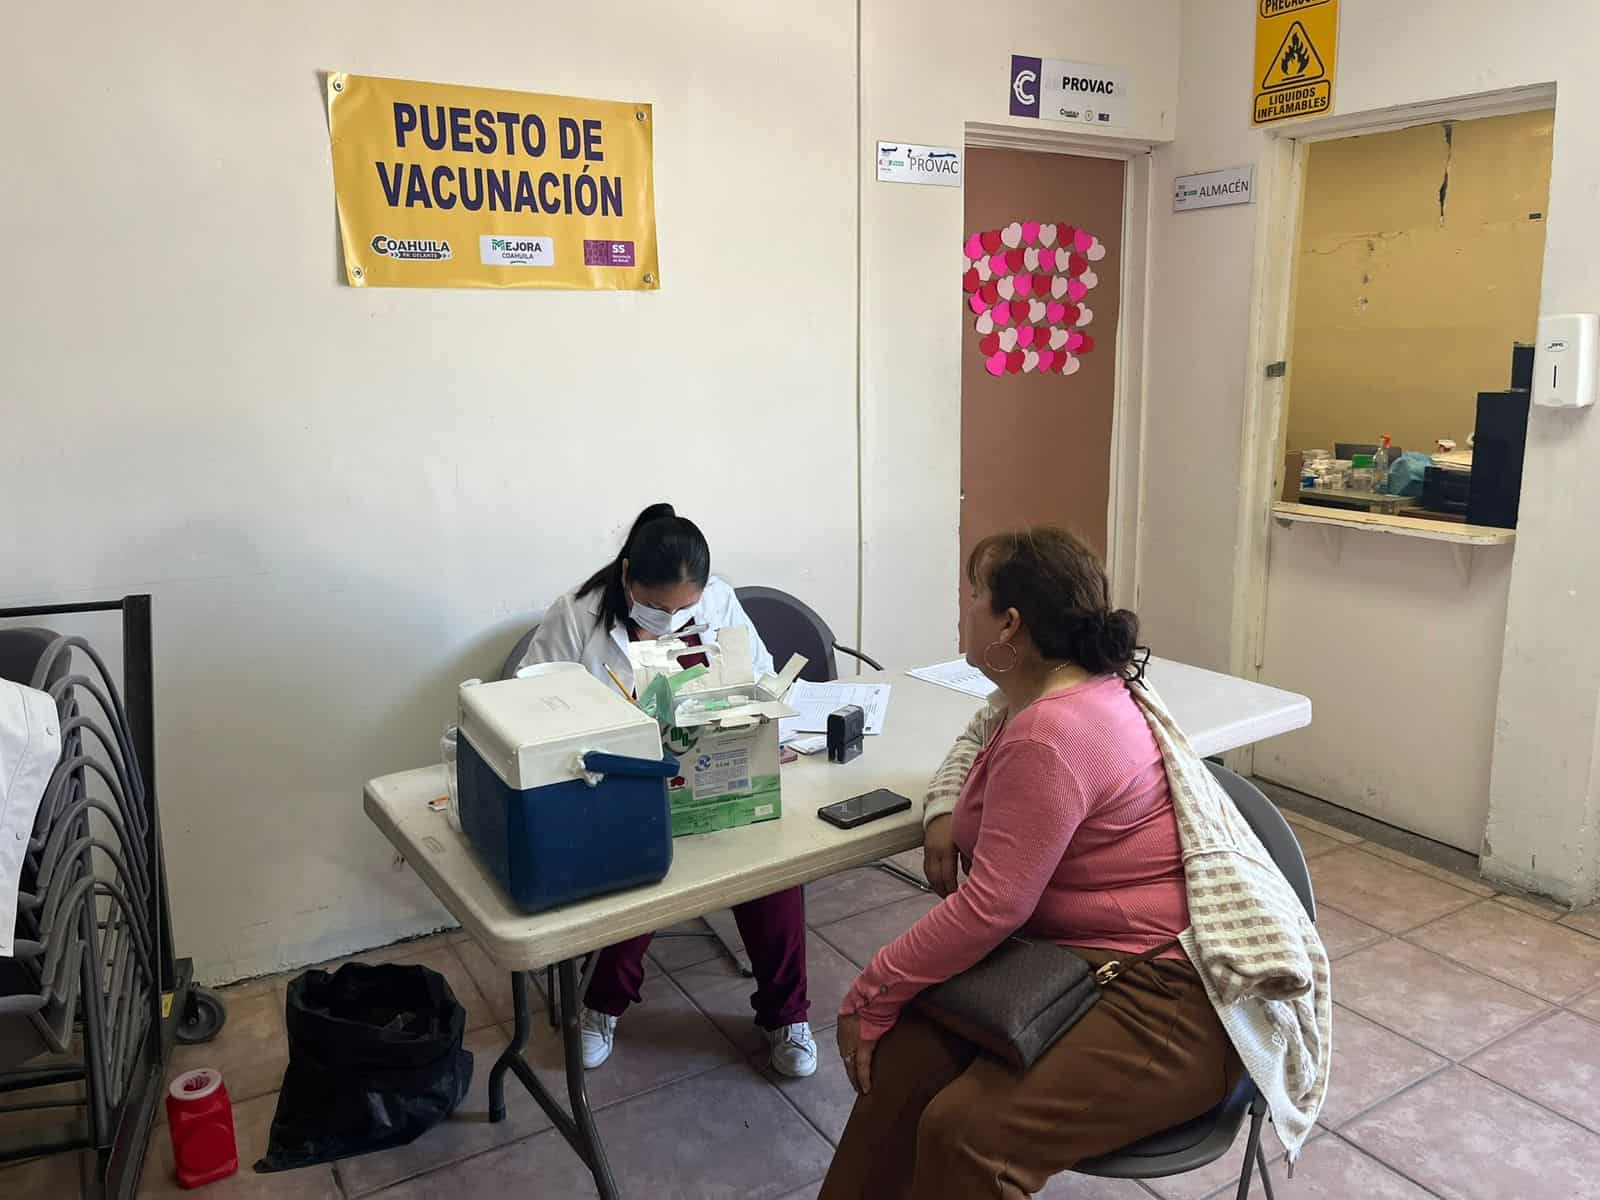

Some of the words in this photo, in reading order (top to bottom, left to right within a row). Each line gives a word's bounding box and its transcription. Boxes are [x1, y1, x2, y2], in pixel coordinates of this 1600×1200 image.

[1062, 76, 1115, 95] PROVAC
[1268, 87, 1316, 105] LIQUIDOS
[1257, 96, 1326, 119] INFLAMABLES
[393, 102, 546, 158] PUESTO
[558, 116, 604, 162] DE
[909, 156, 960, 174] PROVAC
[375, 161, 624, 217] VACUNACIÓN
[1199, 178, 1249, 198] ALMACÉN
[371, 235, 450, 254] COAHUILA
[491, 239, 542, 253] MEJORA
[612, 244, 625, 253] SS
[501, 252, 534, 260] COAHUILA
